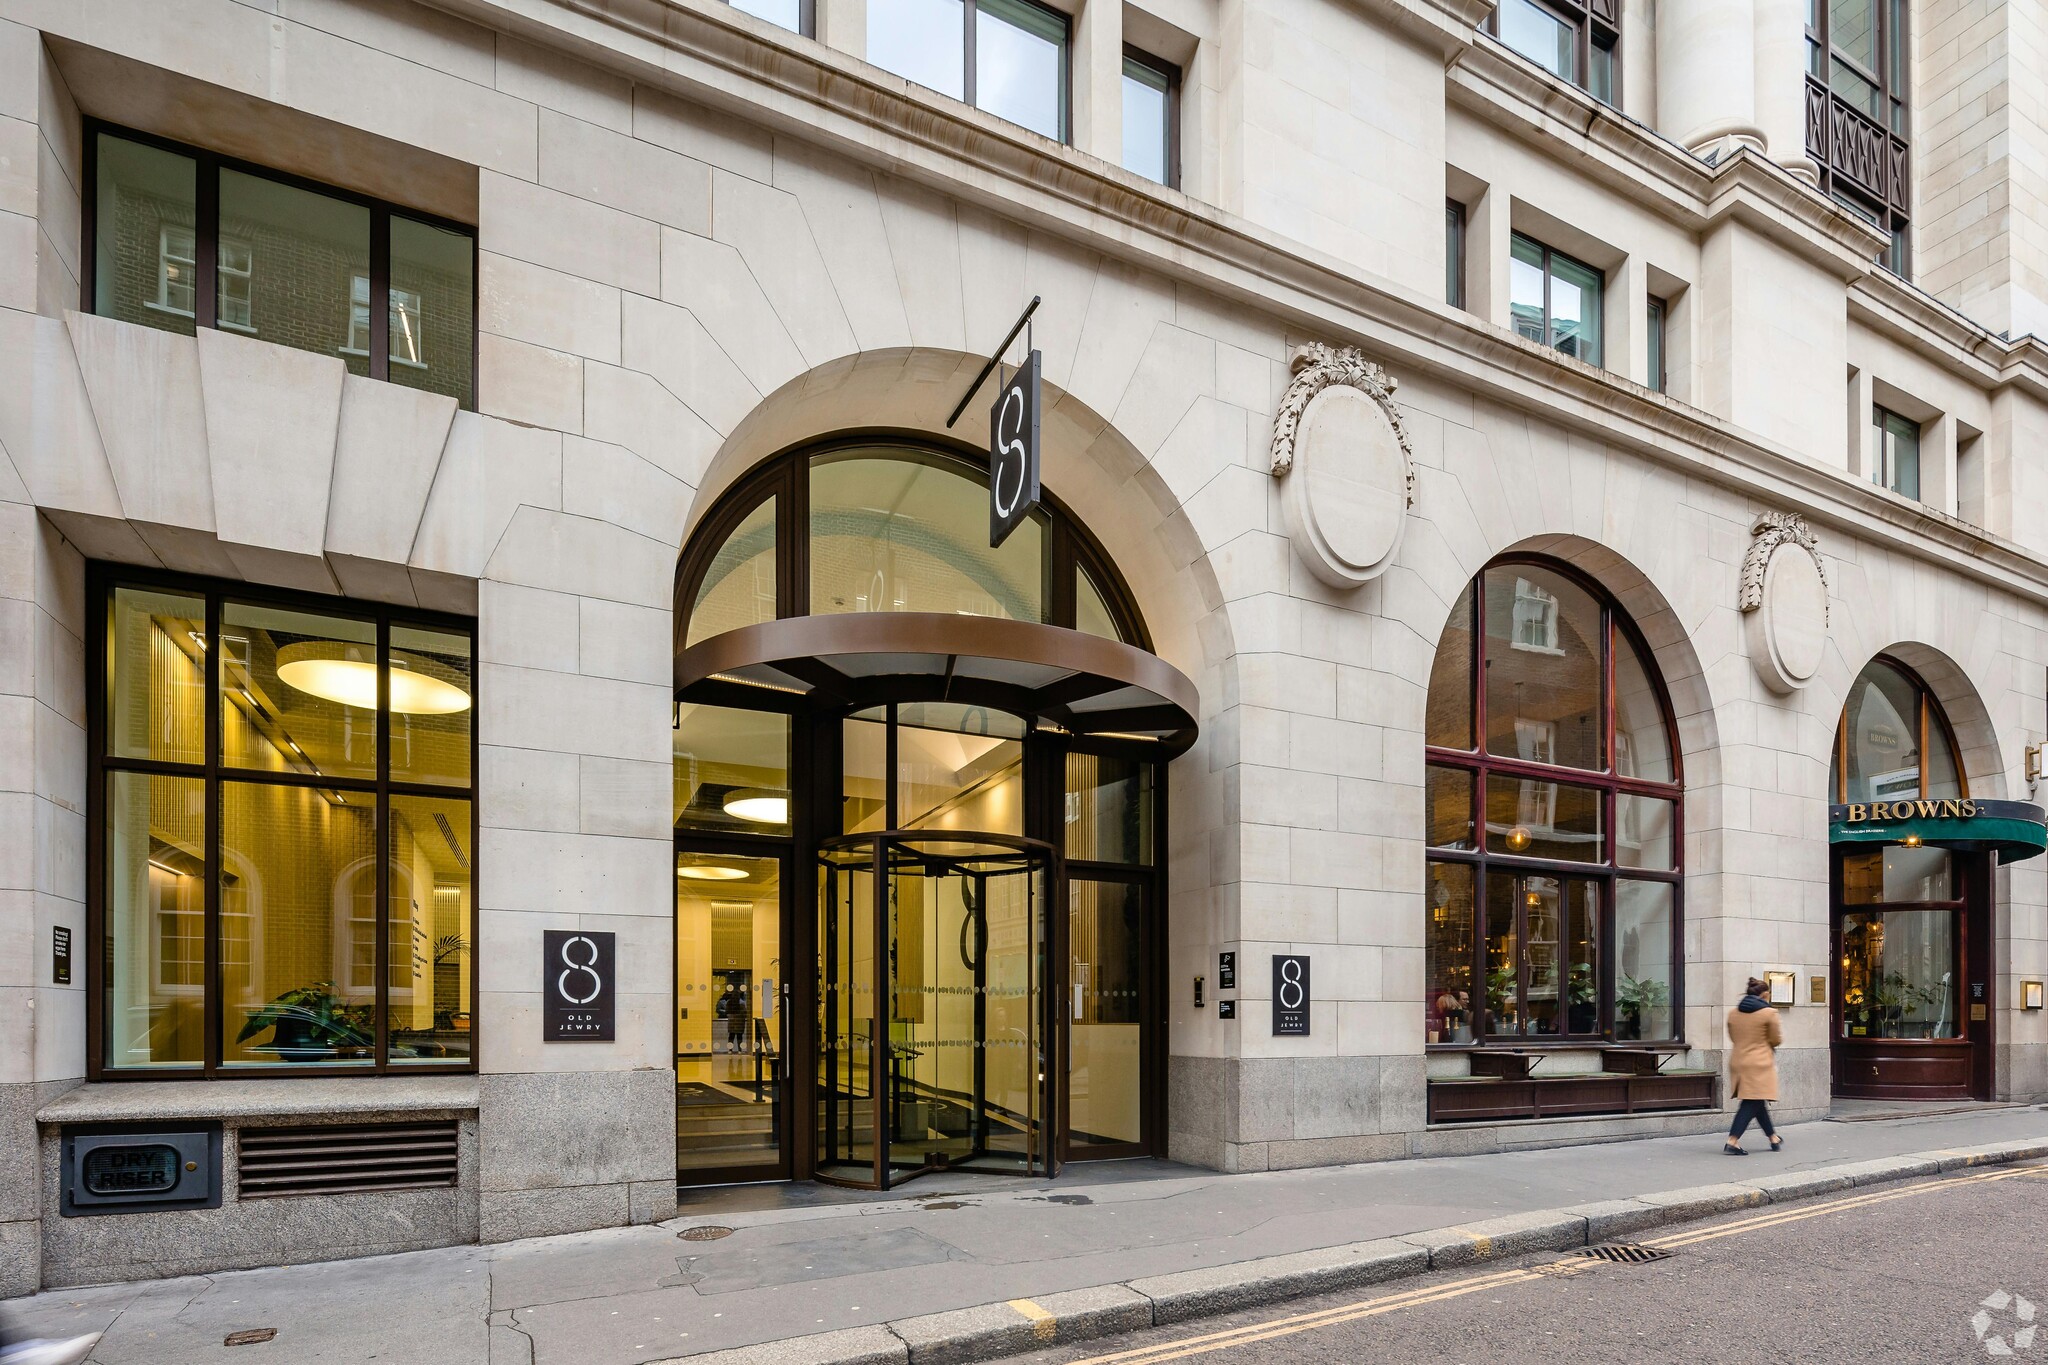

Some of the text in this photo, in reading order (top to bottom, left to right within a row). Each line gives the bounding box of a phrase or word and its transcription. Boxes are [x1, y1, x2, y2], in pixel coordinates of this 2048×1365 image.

[995, 385, 1026, 519] 8
[1870, 732, 1897, 745] BROWNS
[1847, 799, 1977, 823] BROWNS
[558, 936, 601, 1004] 8
[1280, 959, 1303, 1009] 8
[110, 1151, 157, 1168] DRY
[99, 1170, 166, 1187] RISER
